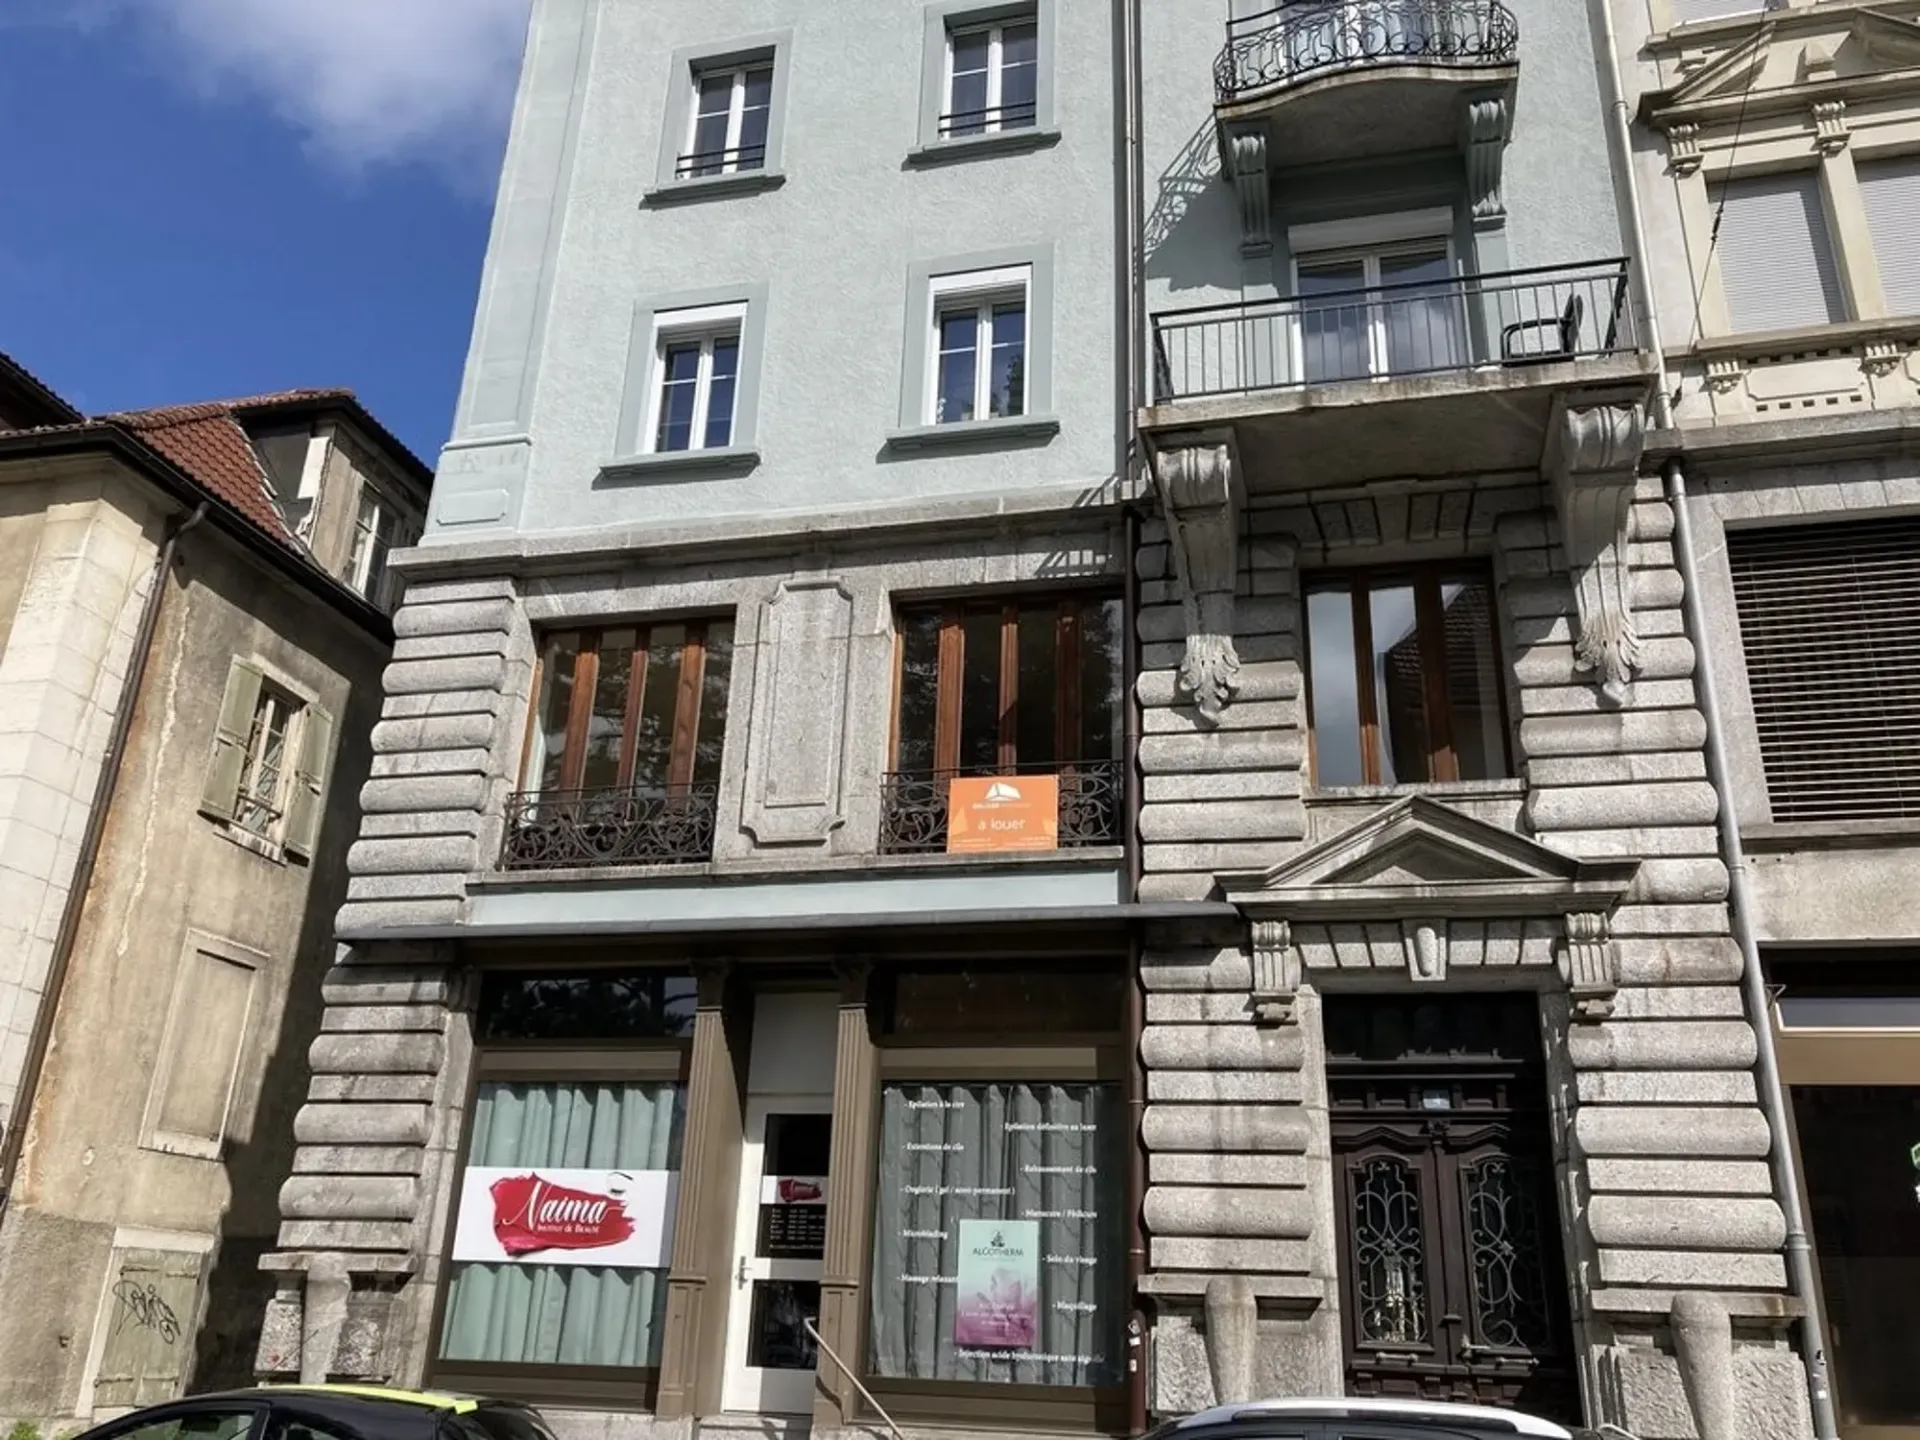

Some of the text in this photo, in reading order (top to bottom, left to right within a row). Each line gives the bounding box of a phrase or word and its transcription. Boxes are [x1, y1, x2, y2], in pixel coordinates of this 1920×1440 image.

[991, 818, 1026, 830] louer
[502, 1180, 624, 1231] Naima
[972, 1247, 1024, 1257] ALGOTHERM
[1047, 1254, 1097, 1266] Soin du visage
[1057, 1301, 1097, 1312] Maquillage
